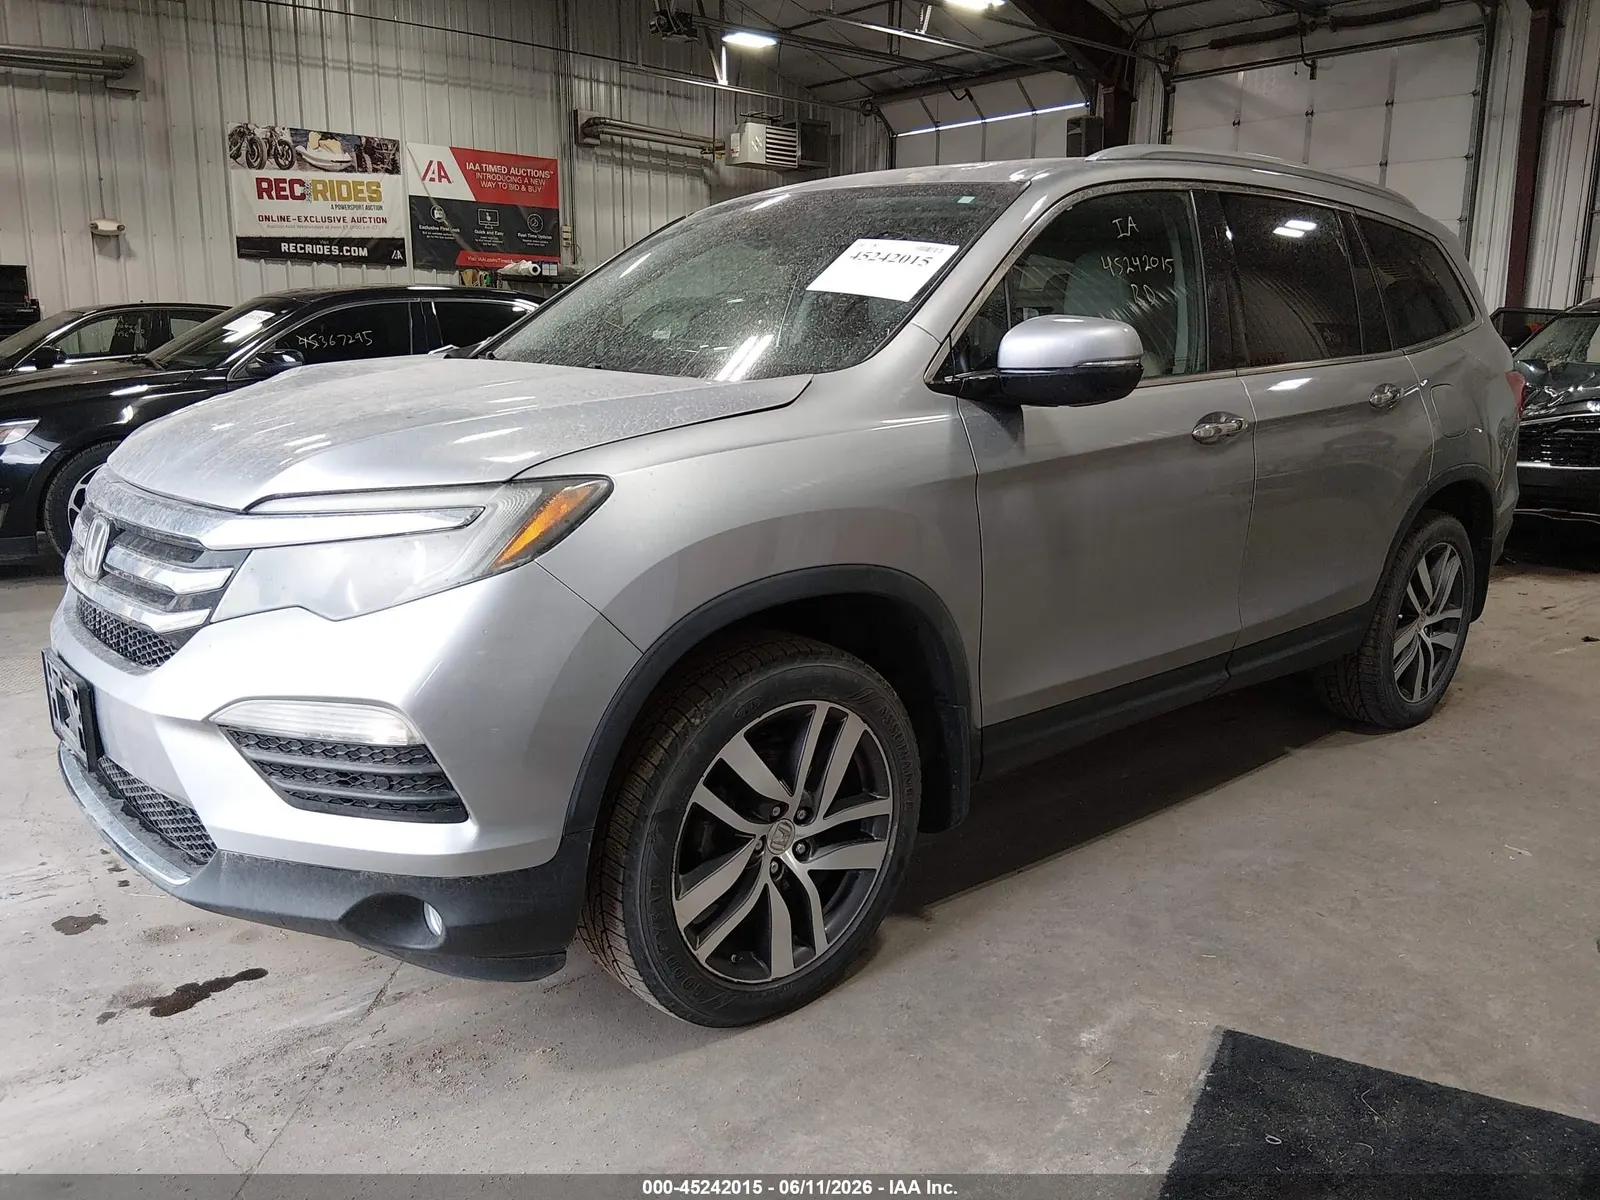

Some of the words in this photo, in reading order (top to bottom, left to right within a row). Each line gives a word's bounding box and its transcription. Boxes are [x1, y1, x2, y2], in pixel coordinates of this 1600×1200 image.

[466, 162, 480, 171] IAA
[481, 164, 508, 174] TIMED
[476, 173, 522, 184] INTRODUCING
[255, 177, 306, 201] REC
[311, 179, 382, 203] RIDES
[497, 182, 508, 190] TO
[509, 183, 520, 191] BID
[528, 185, 542, 193] BUY
[258, 214, 347, 224] ONLINE-EXCLUSIVE
[351, 216, 388, 224] AUCTION
[1112, 215, 1139, 238] IA
[281, 242, 368, 257] RECRIDES.COM
[1101, 255, 1174, 277] 45242015
